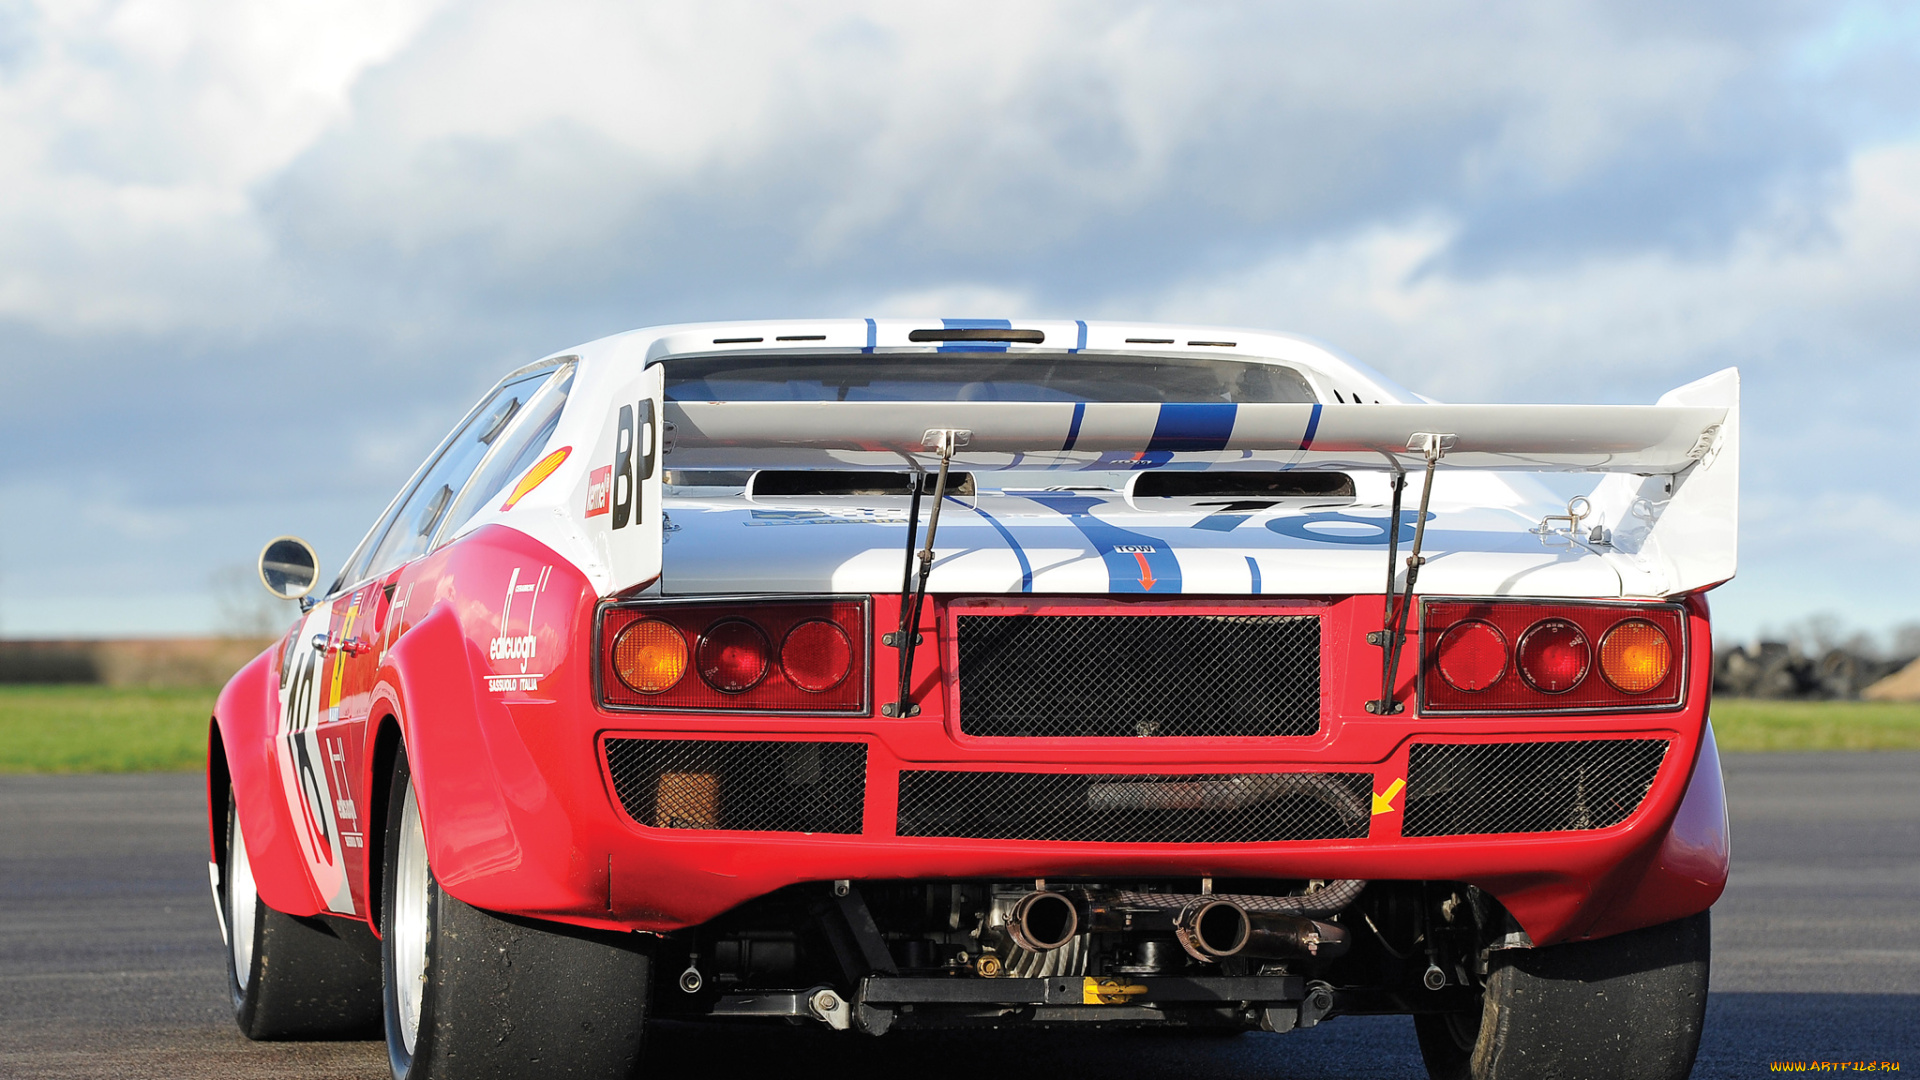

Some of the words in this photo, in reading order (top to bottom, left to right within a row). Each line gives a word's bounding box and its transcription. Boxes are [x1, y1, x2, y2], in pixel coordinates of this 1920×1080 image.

[612, 398, 656, 530] BP
[1190, 500, 1437, 545] 18
[1115, 544, 1152, 553] TOW
[488, 678, 517, 692] SASSUOLO
[519, 678, 538, 691] ITALIA
